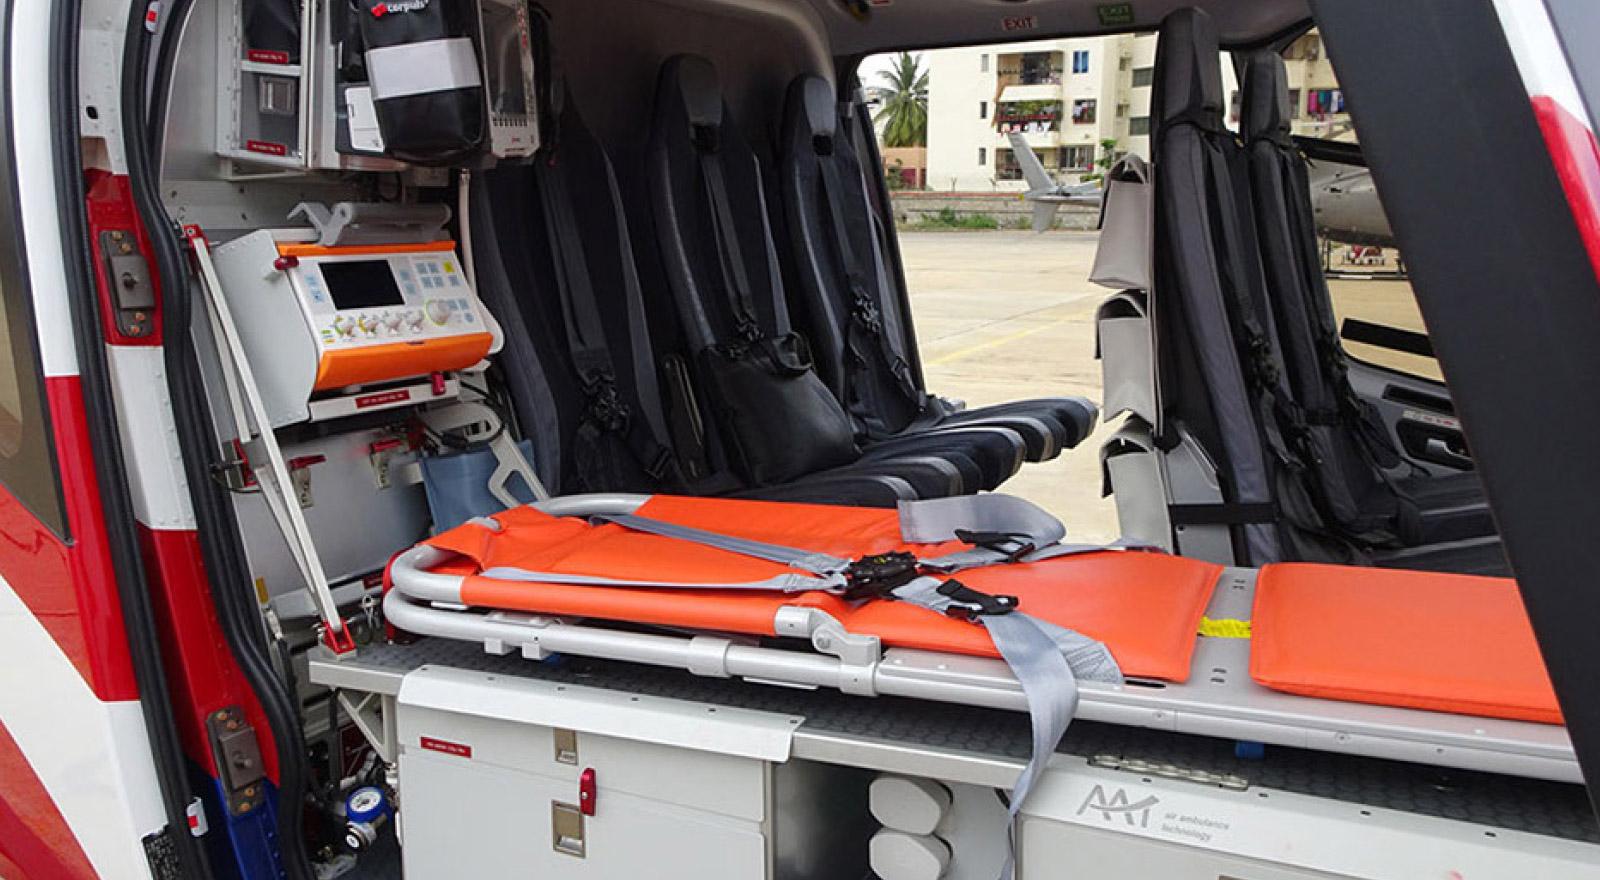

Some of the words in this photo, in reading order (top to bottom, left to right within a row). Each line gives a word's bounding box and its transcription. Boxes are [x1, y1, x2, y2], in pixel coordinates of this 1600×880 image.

[1003, 16, 1032, 30] EXIT
[1164, 812, 1177, 821] air
[1179, 813, 1230, 830] ambulance
[1161, 823, 1212, 841] technology
